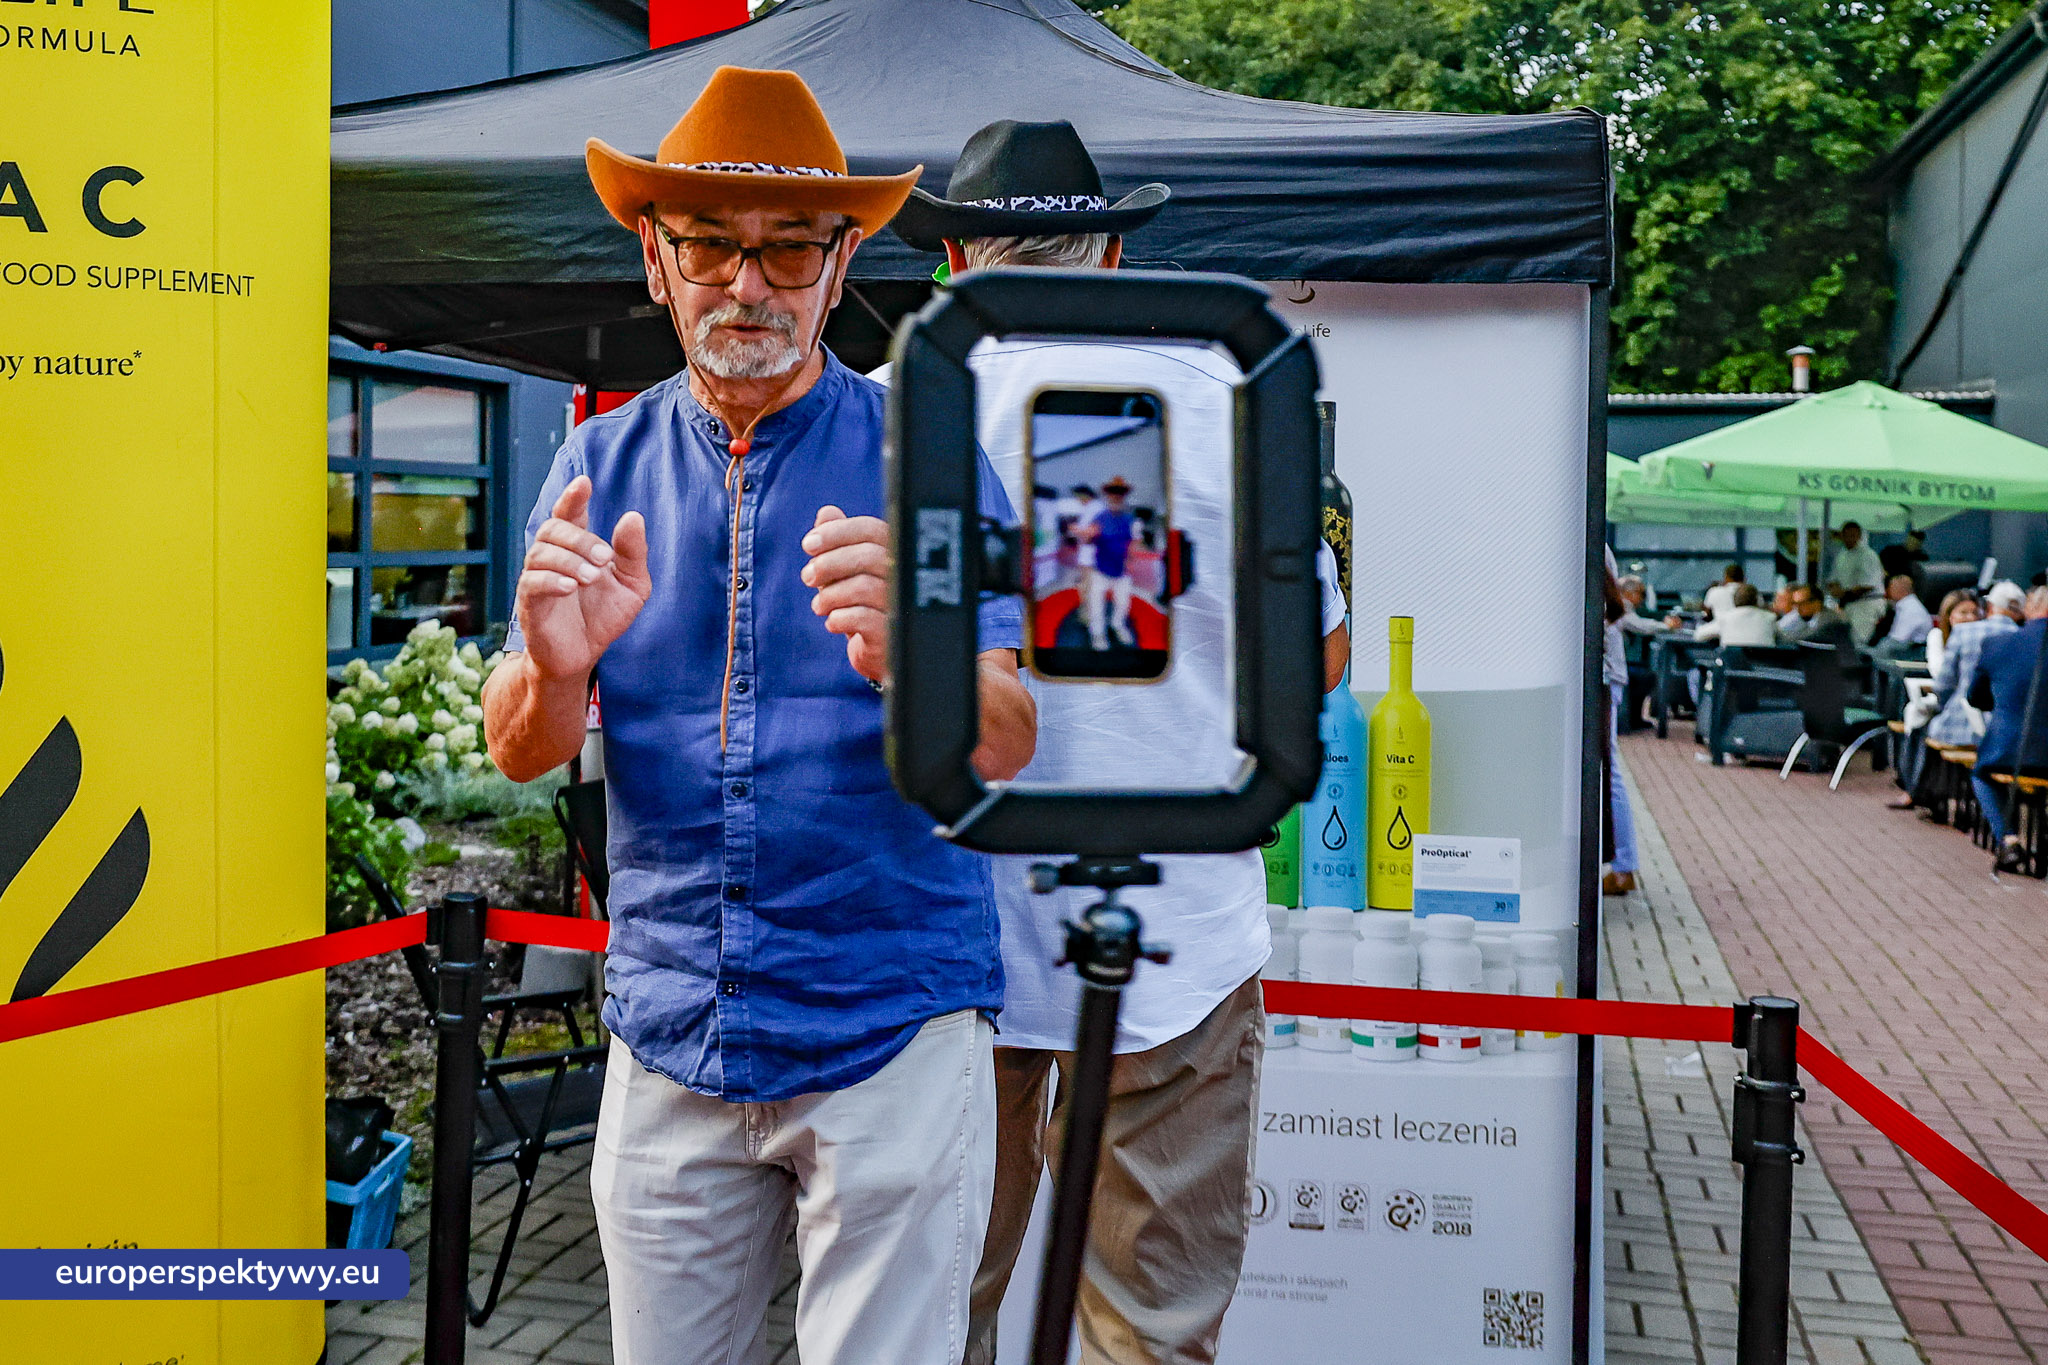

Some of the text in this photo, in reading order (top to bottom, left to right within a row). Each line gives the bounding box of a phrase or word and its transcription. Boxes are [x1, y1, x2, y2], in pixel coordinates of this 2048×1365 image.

[0, 261, 255, 297] OOD SUPPLEMENT
[1797, 472, 1823, 490] KS
[1918, 480, 1996, 503] BYTOM
[1386, 754, 1416, 764] Vita C
[1263, 1108, 1518, 1147] zamiast leczenia
[1431, 1220, 1472, 1236] 2018
